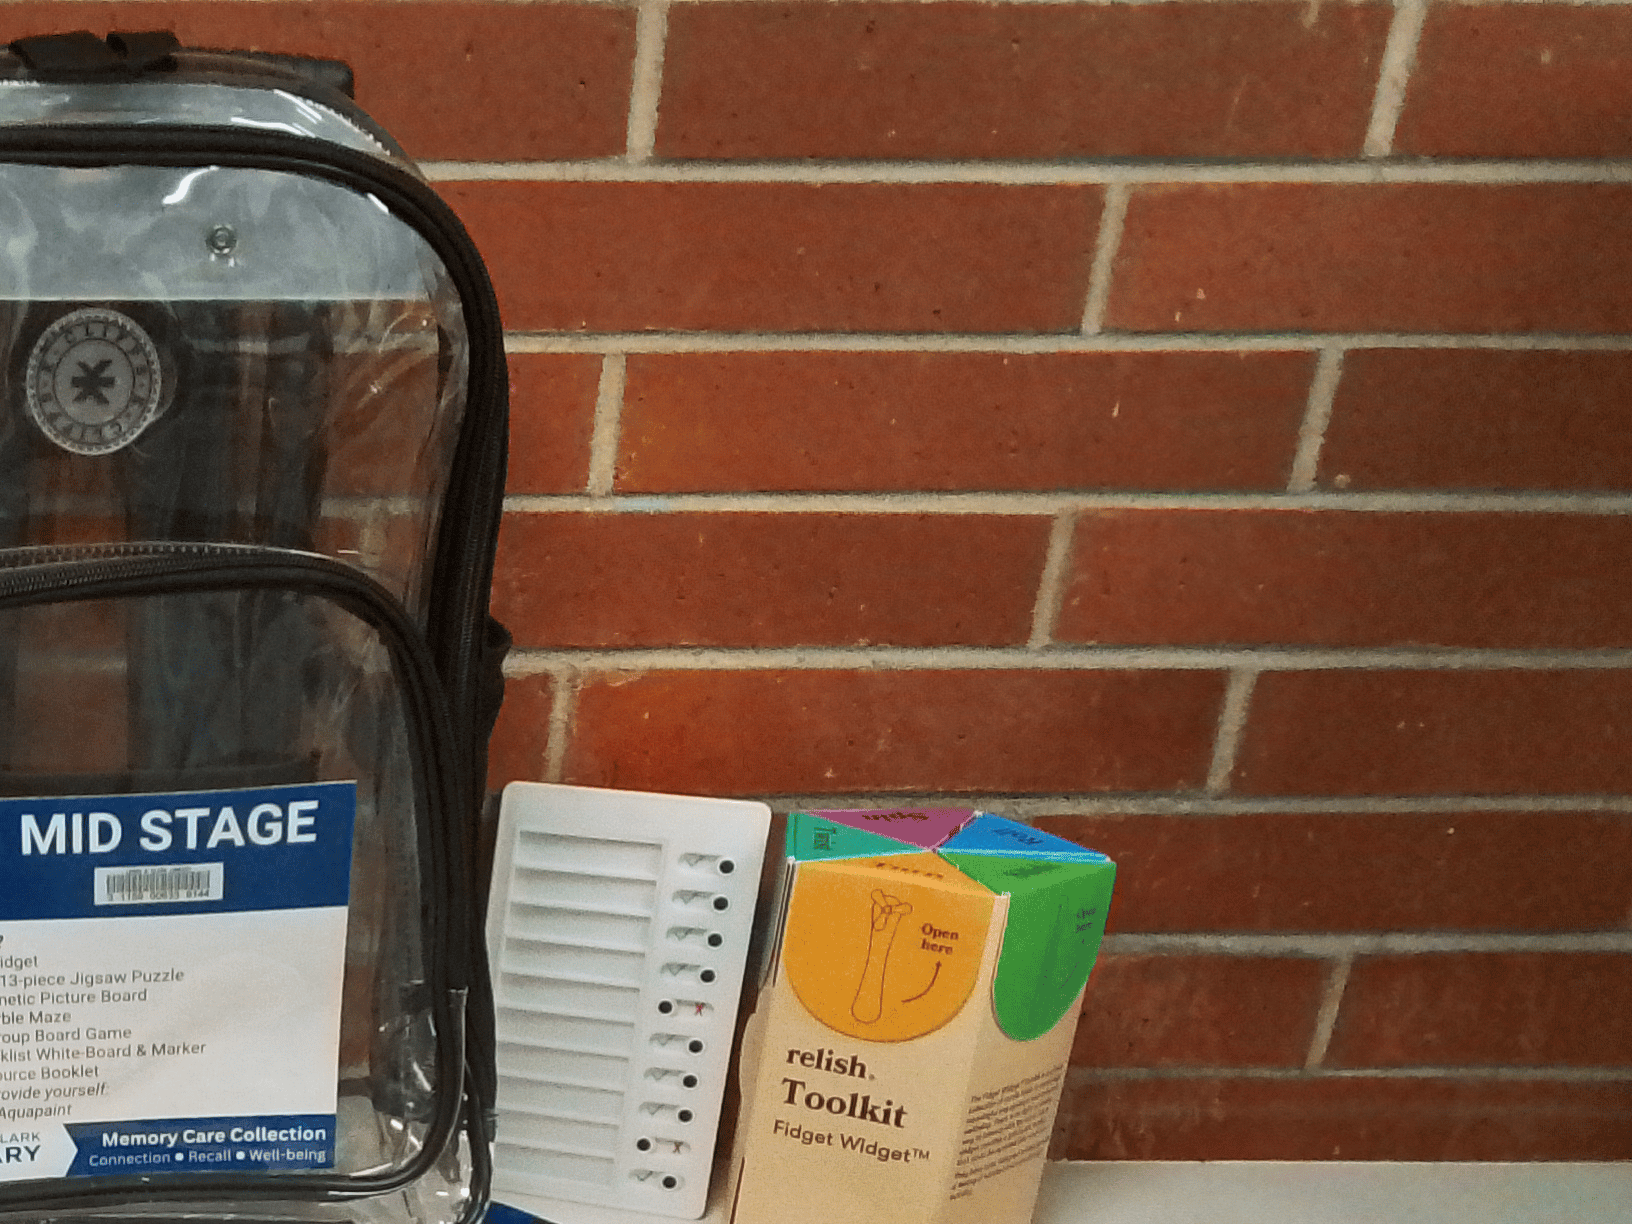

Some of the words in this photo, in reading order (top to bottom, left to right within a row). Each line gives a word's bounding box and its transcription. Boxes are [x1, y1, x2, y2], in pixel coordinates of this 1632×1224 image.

[20, 811, 122, 856] MID
[139, 799, 319, 852] STAGE
[921, 923, 959, 941] Open
[921, 938, 954, 955] here
[0, 973, 65, 989] 13-piece
[70, 971, 127, 988] Jigsaw
[132, 968, 184, 983] Puzzle
[40, 991, 96, 1005] Picture
[101, 988, 147, 1003] Board
[29, 1010, 72, 1024] Maze
[35, 1027, 81, 1042] Board
[86, 1027, 132, 1040] Game
[36, 1044, 131, 1061] White-Board
[136, 1044, 146, 1057] &
[151, 1042, 206, 1056] Marker
[41, 1064, 99, 1079] Booklet
[781, 1077, 908, 1129] Toolkit
[102, 1131, 178, 1148] Memory
[182, 1129, 226, 1143] Care
[230, 1125, 327, 1142] Collection
[773, 1118, 833, 1146] Fidget
[89, 1151, 171, 1167] Connection
[188, 1148, 232, 1162] Recall
[249, 1148, 326, 1164] Well-being
